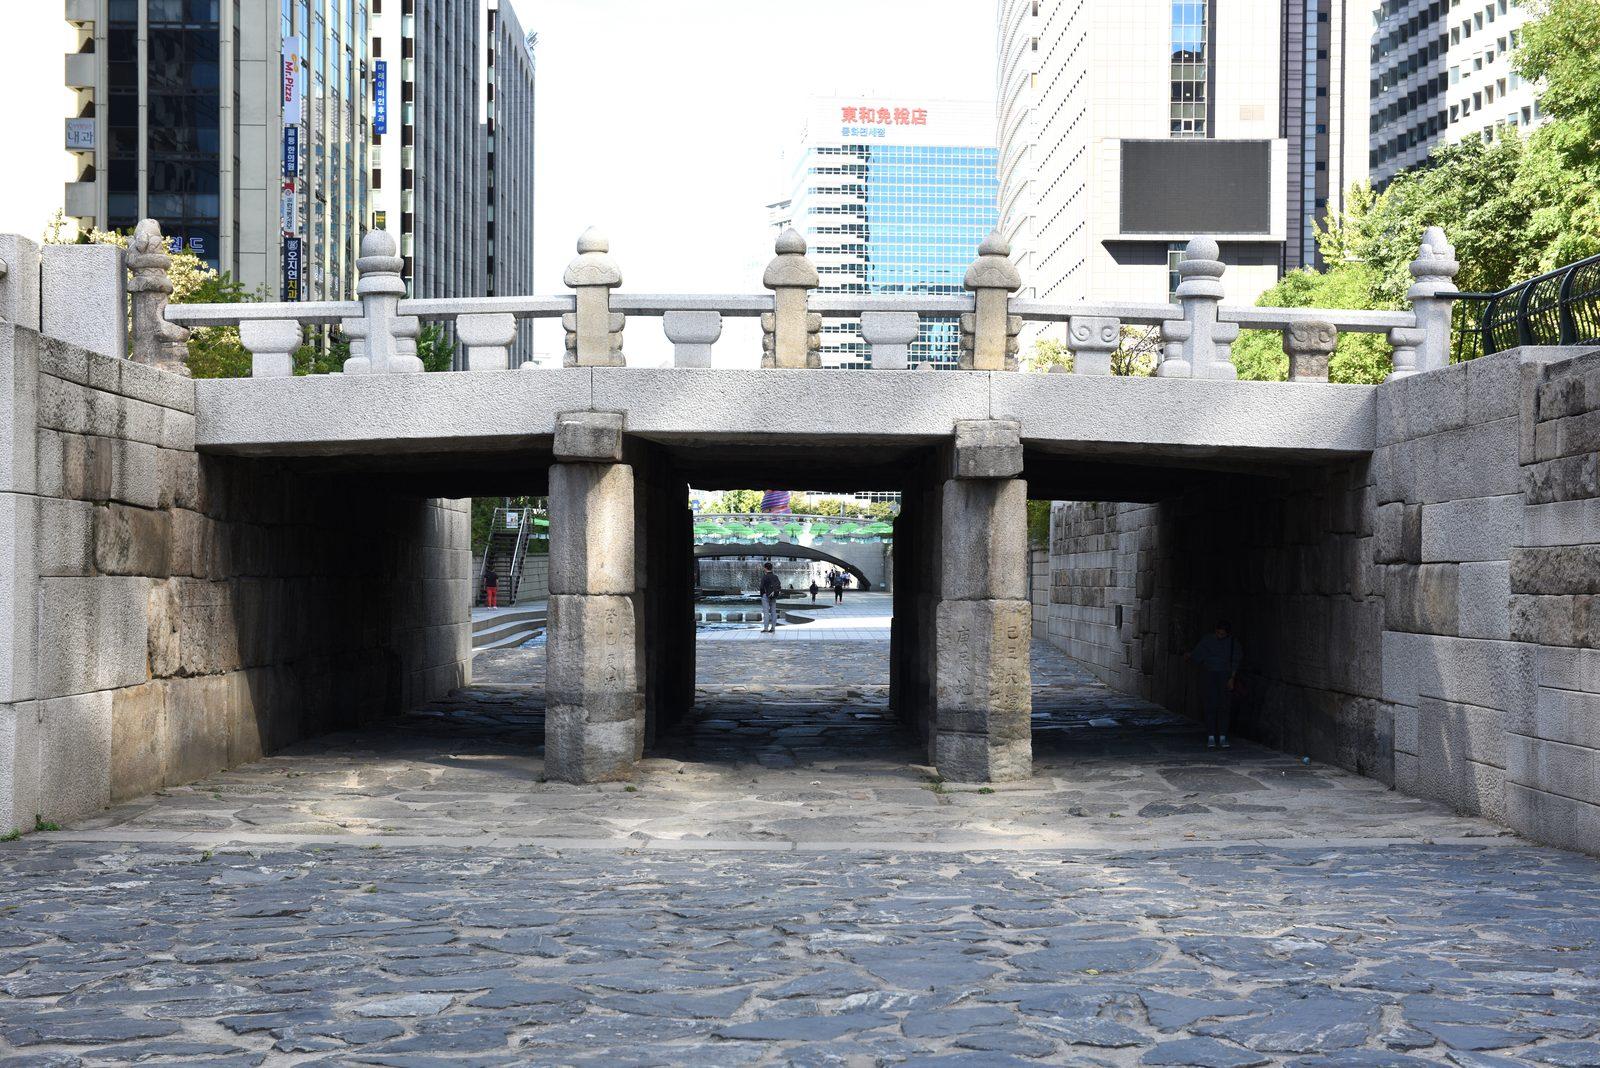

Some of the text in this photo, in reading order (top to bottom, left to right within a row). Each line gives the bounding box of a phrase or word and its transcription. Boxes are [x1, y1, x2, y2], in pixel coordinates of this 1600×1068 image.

[285, 61, 294, 102] Mr.Pizza
[377, 64, 385, 122] 미래이비인후과
[67, 131, 94, 145] 내과
